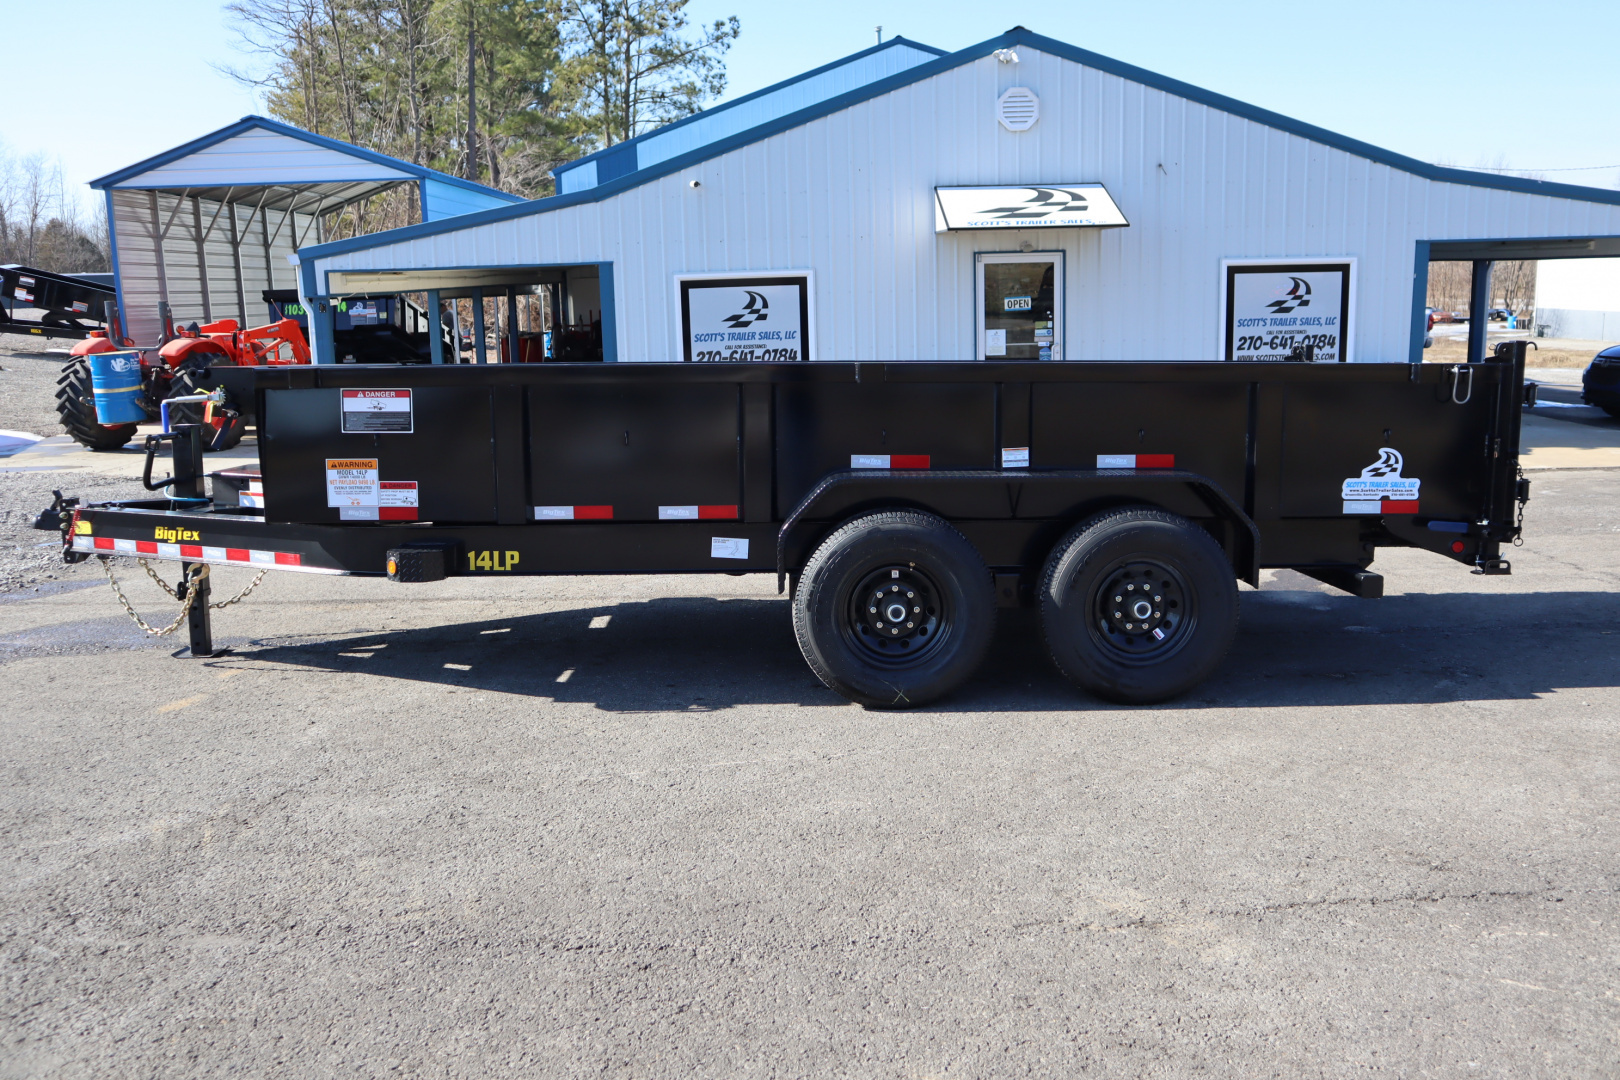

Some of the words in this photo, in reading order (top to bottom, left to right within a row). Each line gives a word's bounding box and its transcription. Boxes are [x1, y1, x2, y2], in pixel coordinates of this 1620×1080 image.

[1007, 299, 1030, 309] OPEN
[1237, 318, 1268, 328] SCOTT'S
[1269, 317, 1298, 327] TRAILER
[1299, 316, 1323, 327] SALES,
[1324, 316, 1337, 326] LLC
[694, 332, 726, 343] SCOTT'S
[727, 331, 757, 341] TRAILER
[758, 330, 783, 341] SALES,
[784, 330, 797, 340] LLC
[1390, 481, 1407, 489] SALES,
[154, 526, 200, 543] BigTex
[467, 550, 520, 571] 14LP
